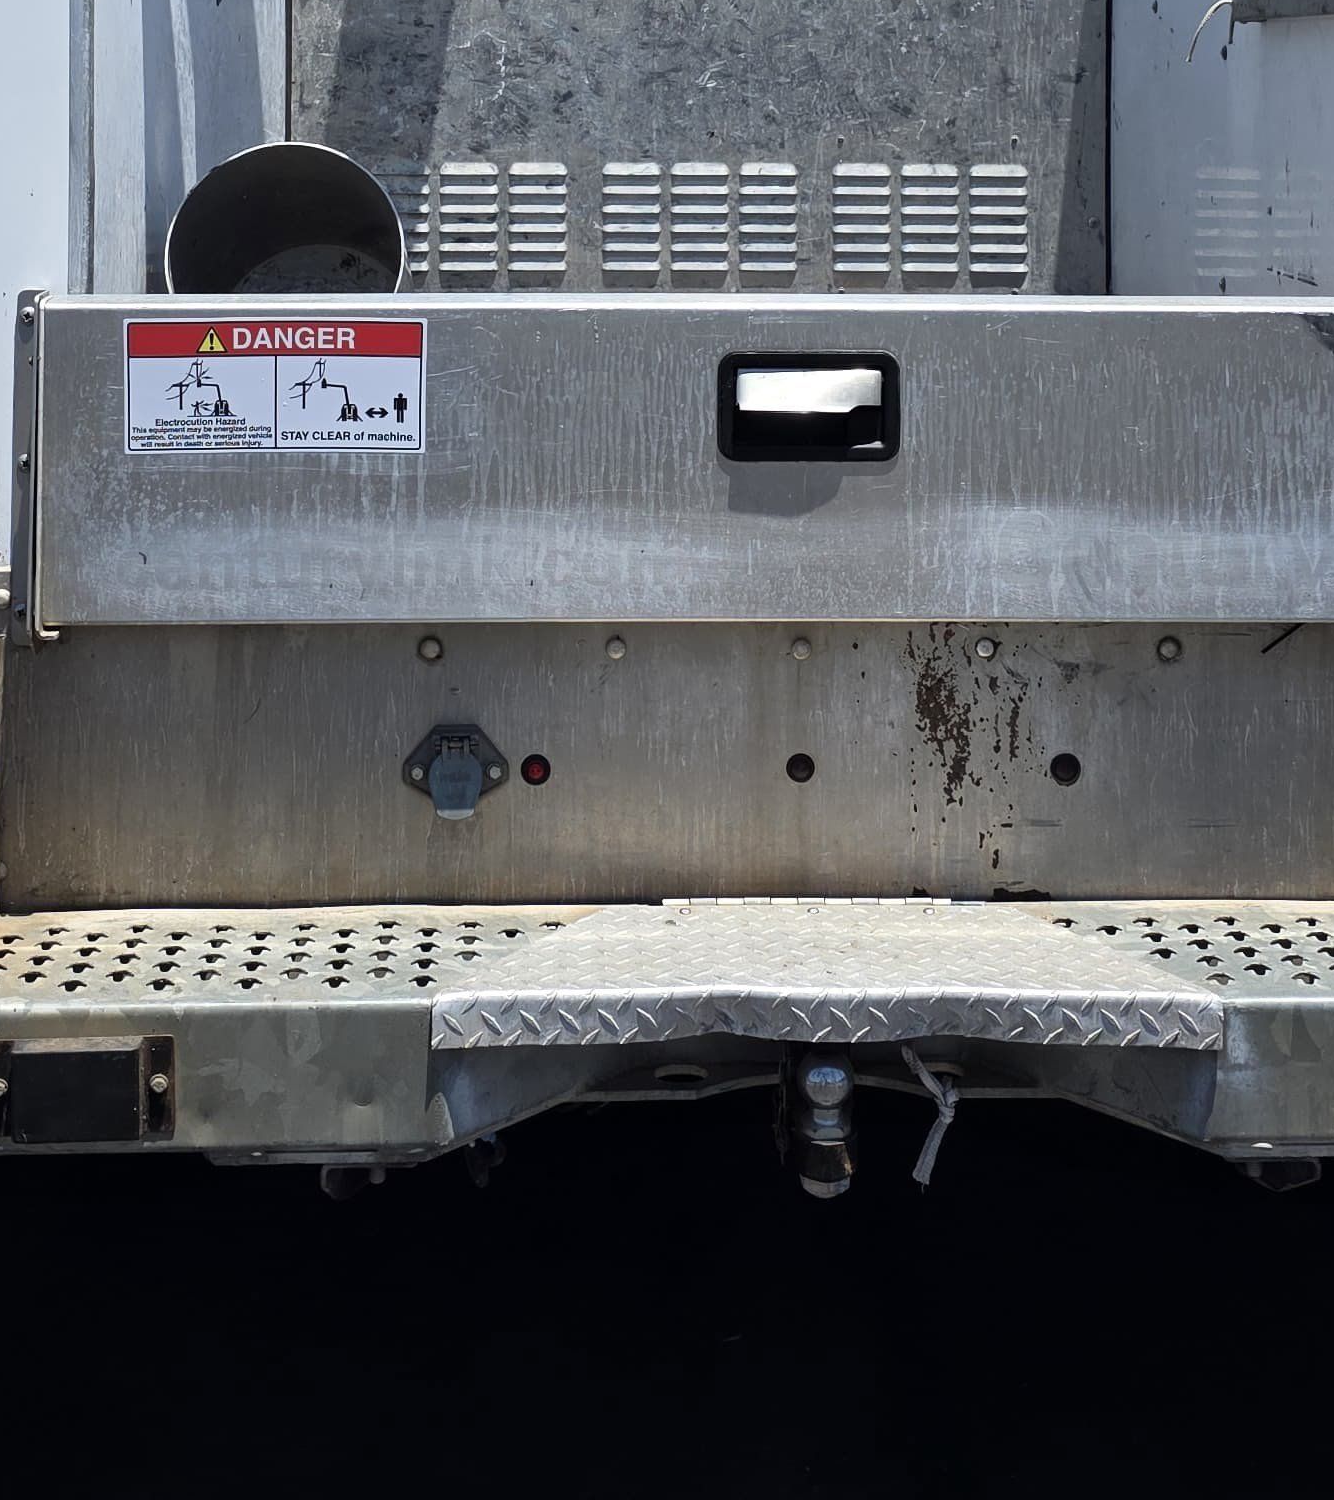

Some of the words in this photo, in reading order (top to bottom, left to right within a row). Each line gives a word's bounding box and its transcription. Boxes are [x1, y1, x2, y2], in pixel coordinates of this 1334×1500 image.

[232, 327, 356, 350] DANGER
[155, 418, 212, 427] Electrocution
[216, 418, 246, 426] Hazard
[149, 427, 185, 435] equipment
[249, 425, 271, 433] during
[212, 433, 246, 441] energized
[281, 431, 309, 442] STAY
[312, 431, 351, 442] CLEAR
[353, 430, 365, 442] of
[368, 430, 416, 442] machine.
[241, 440, 263, 448] injury.
